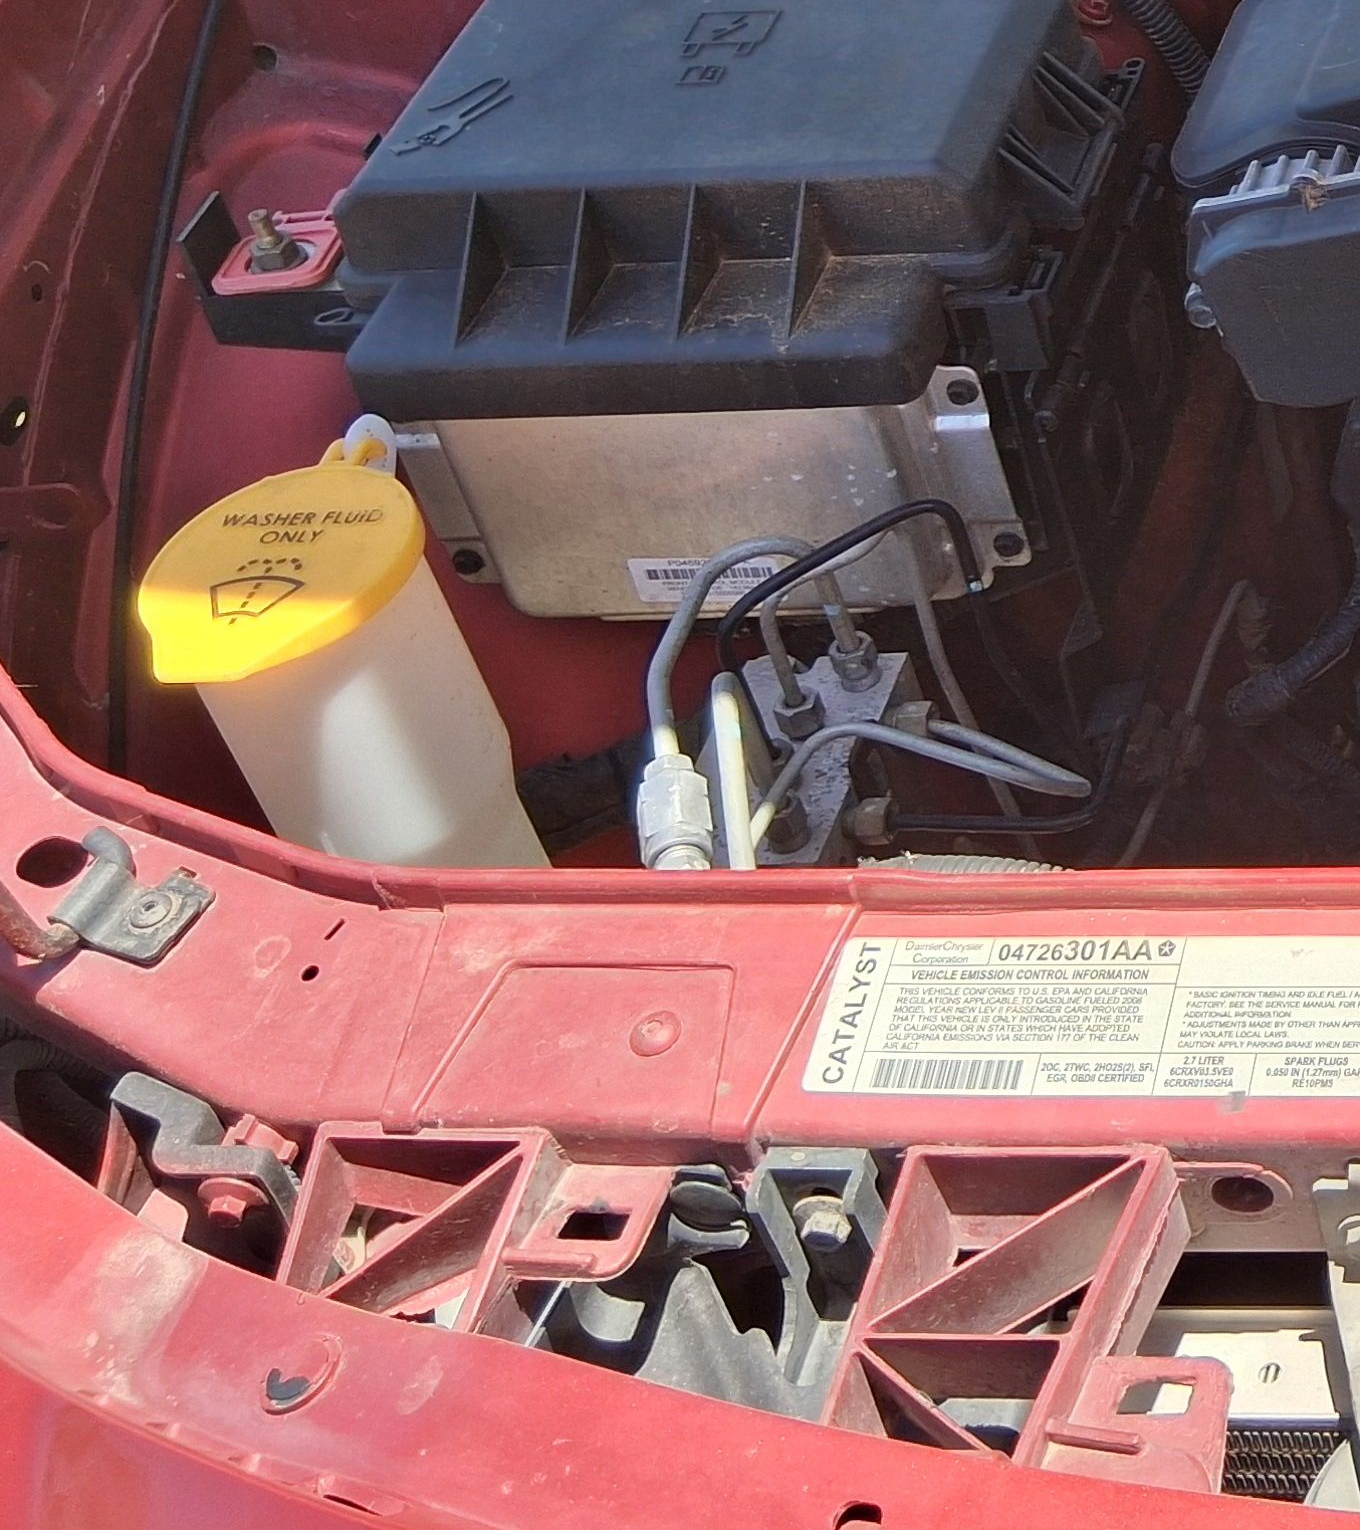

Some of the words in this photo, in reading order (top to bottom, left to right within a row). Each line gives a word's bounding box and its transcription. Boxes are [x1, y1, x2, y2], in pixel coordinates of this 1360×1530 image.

[223, 511, 317, 527] WASHER
[322, 508, 384, 524] FLUID
[259, 529, 325, 545] ONLY
[998, 940, 1152, 961] 04726301AA
[911, 969, 959, 980] VEHICLE
[959, 969, 1014, 980] EMISSION
[1015, 969, 1069, 980] CONTROL
[1071, 969, 1150, 980] INFORMATION
[899, 987, 920, 995] THIS
[922, 987, 961, 996] VEHICLE
[962, 987, 1016, 995] CONFORMS
[1017, 987, 1031, 996] TO
[1051, 987, 1070, 995] EPA
[1071, 987, 1092, 995] AND
[1093, 987, 1148, 995] CALIFORNIA
[821, 944, 881, 1083] CATALYST
[1197, 1055, 1225, 1065] LITER
